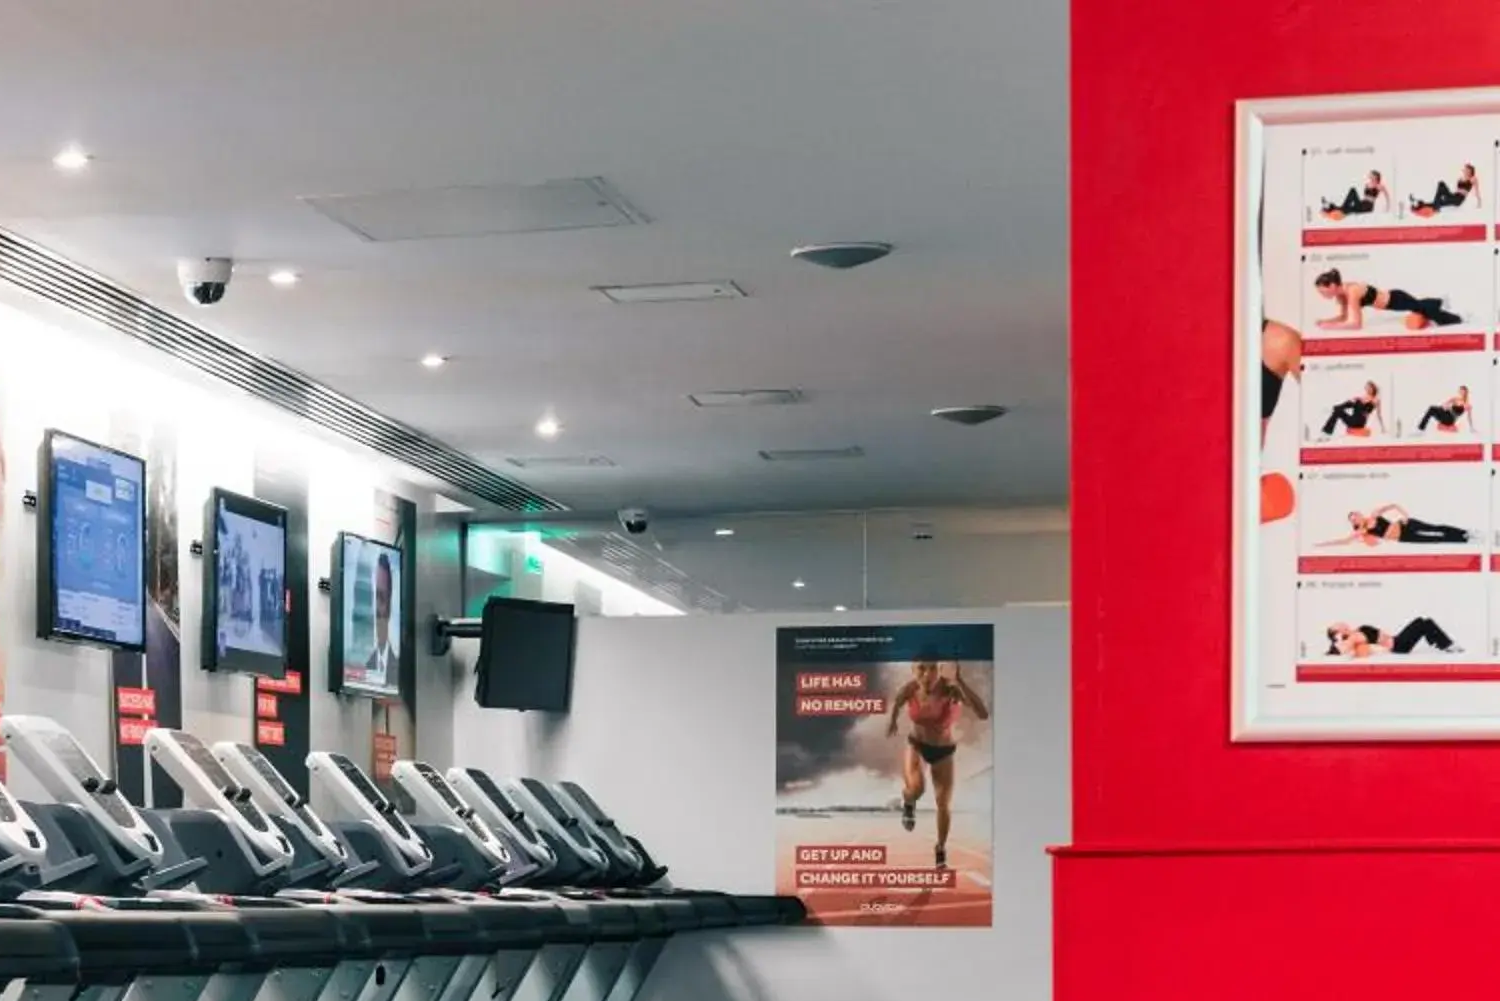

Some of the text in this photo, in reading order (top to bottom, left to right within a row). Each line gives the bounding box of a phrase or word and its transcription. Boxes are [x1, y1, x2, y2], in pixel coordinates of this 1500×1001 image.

[801, 675, 861, 689] LIFE HAS
[801, 699, 884, 713] NO REMOTE
[801, 850, 883, 861] GET UP AND
[801, 872, 950, 885] CHANGE IT YOURSELF
